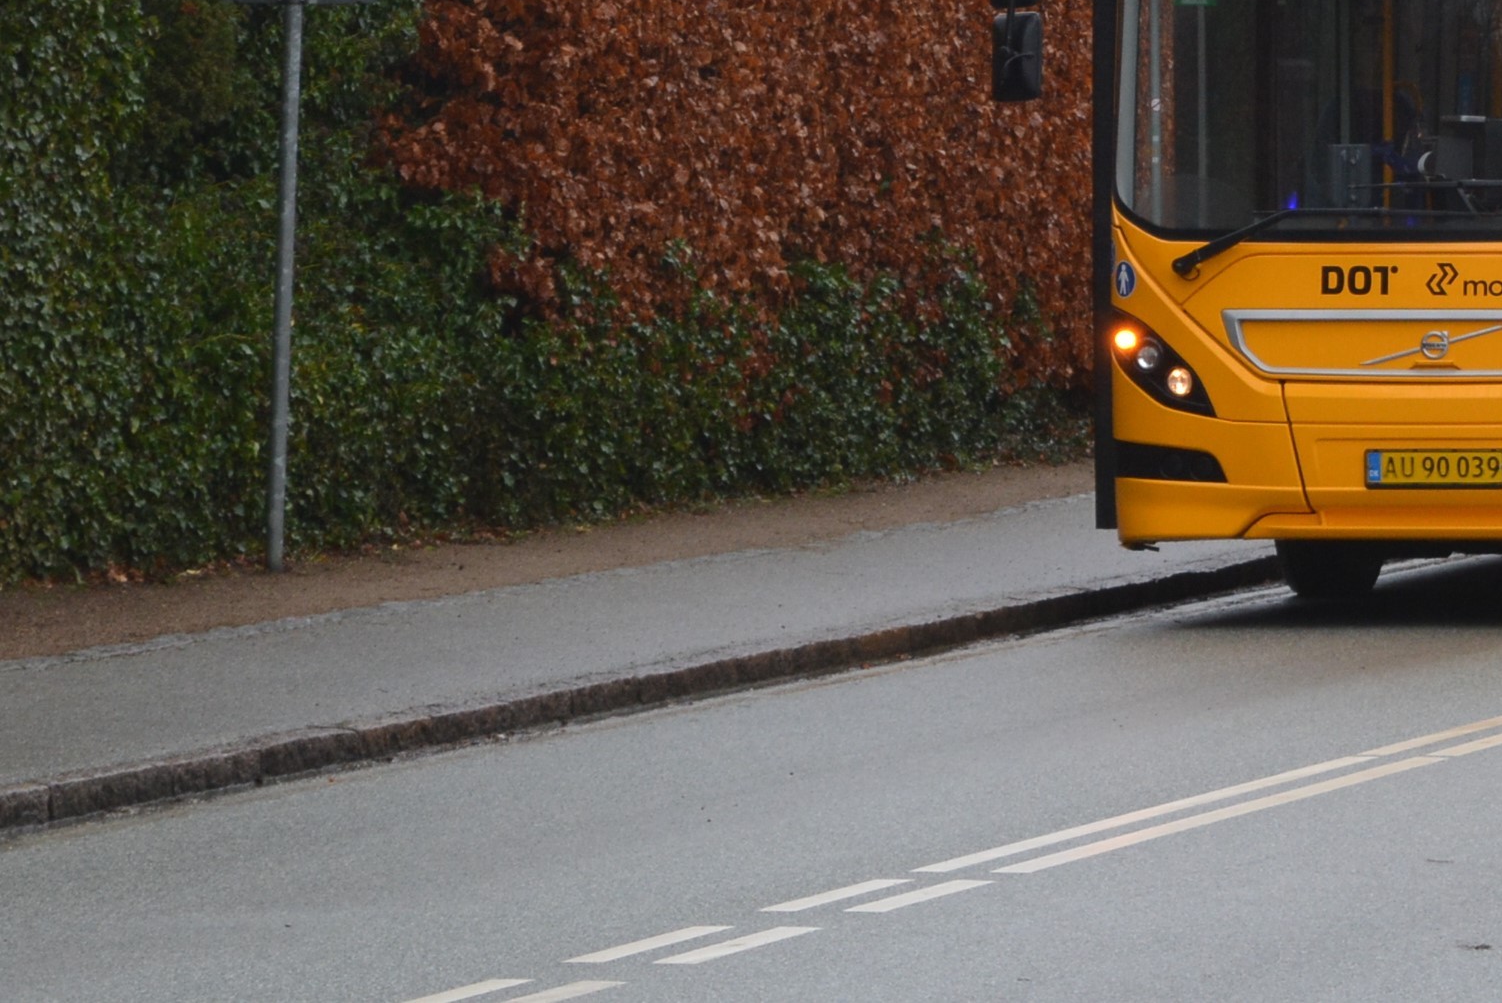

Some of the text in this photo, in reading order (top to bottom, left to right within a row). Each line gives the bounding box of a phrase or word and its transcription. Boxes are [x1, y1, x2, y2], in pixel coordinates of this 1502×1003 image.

[1321, 265, 1398, 295] DOT
[1385, 456, 1415, 478] AU
[1422, 456, 1450, 478] 90
[1457, 456, 1500, 478] 039
